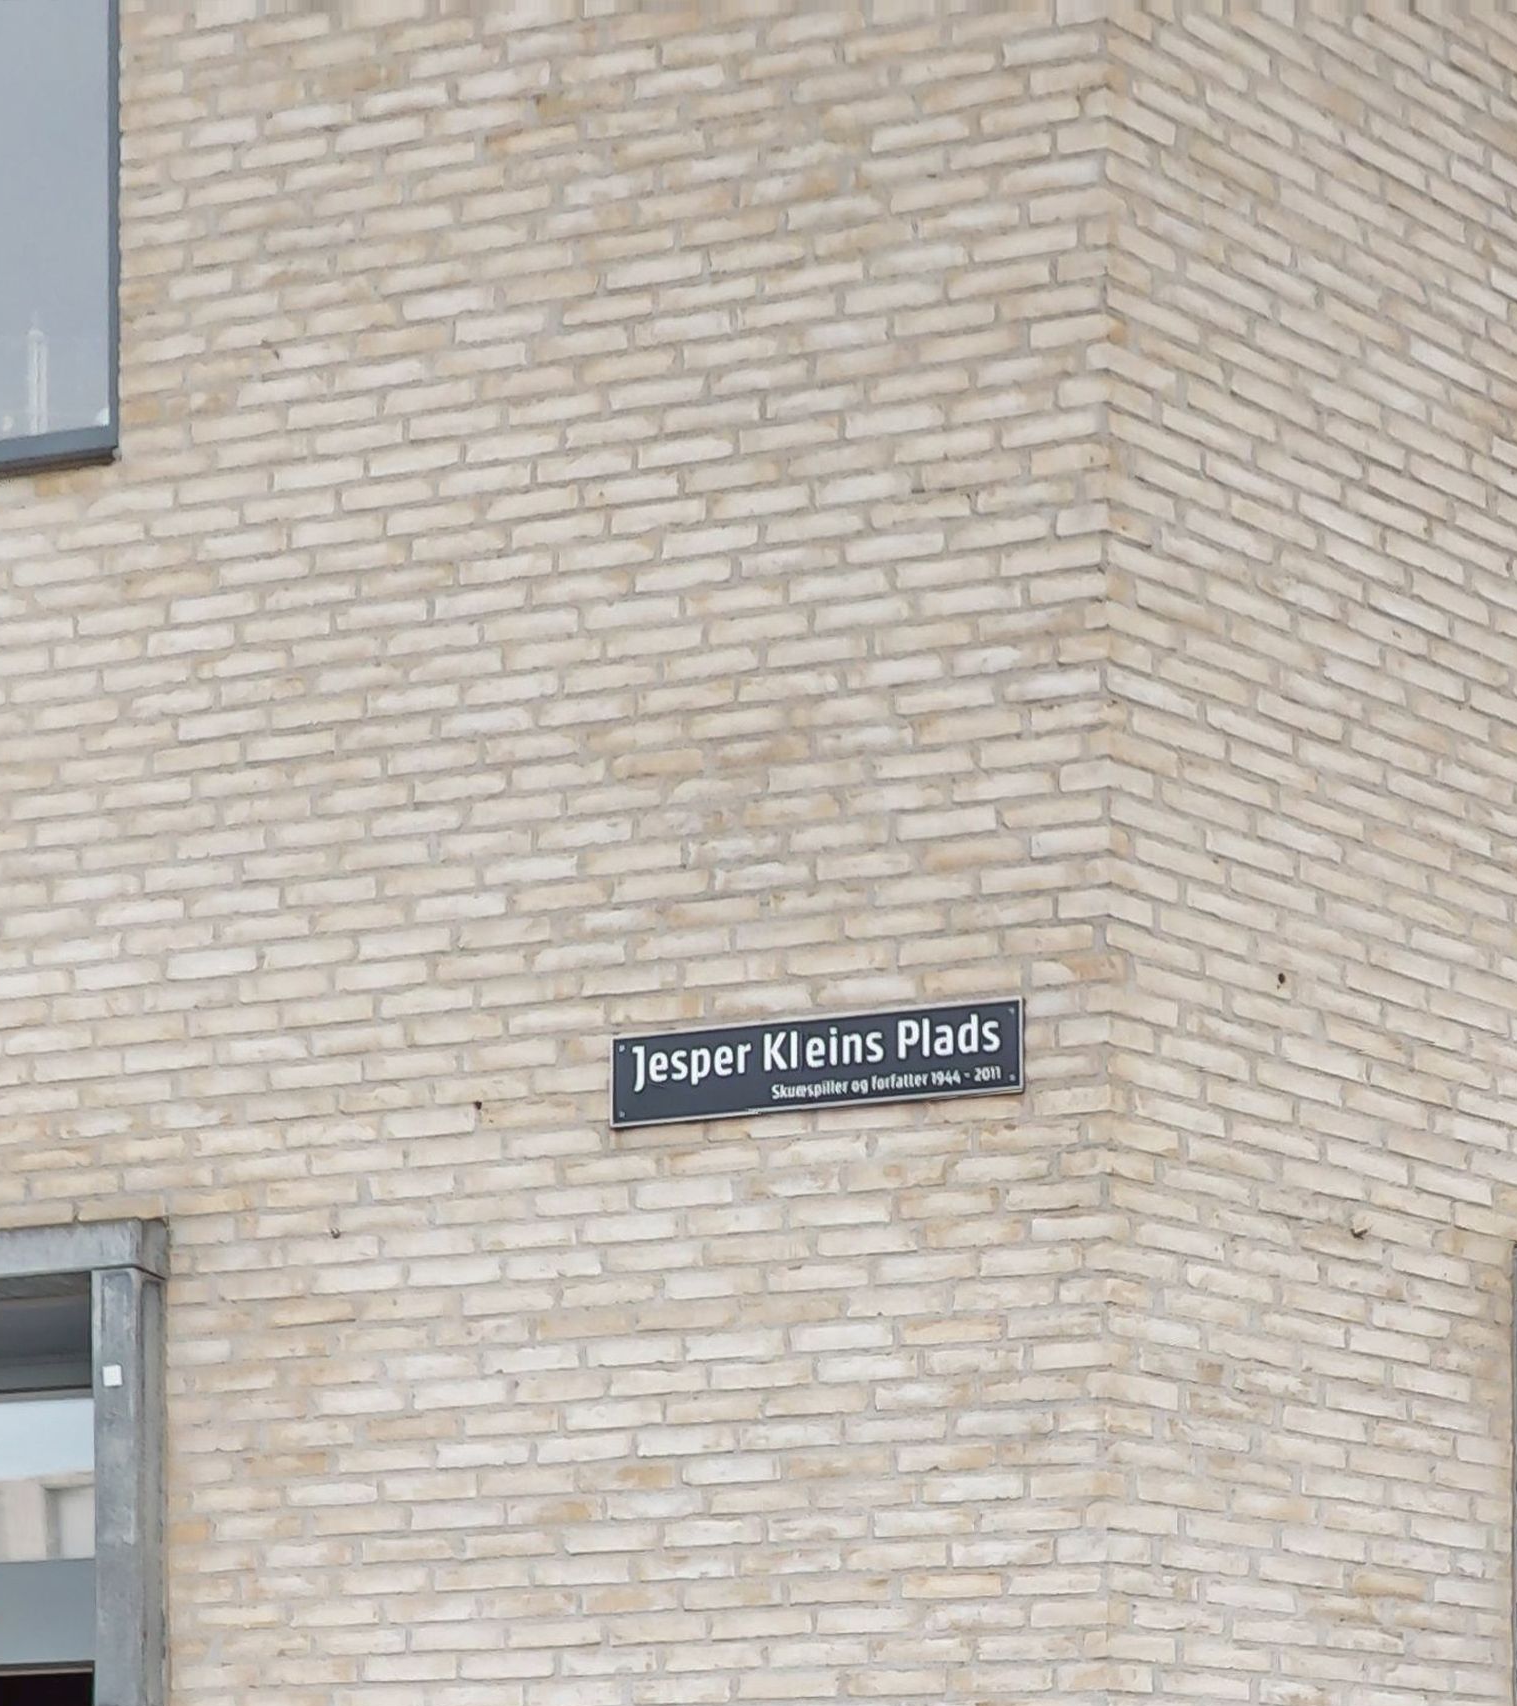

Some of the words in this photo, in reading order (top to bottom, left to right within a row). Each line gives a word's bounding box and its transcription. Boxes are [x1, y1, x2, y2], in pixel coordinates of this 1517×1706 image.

[632, 1042, 752, 1093] Jesper
[763, 1028, 884, 1073] Kleins
[897, 1013, 1001, 1060] Plads
[851, 1078, 869, 1095] og
[871, 1072, 929, 1091] forfatter
[930, 1069, 962, 1087] 1944
[974, 1065, 1002, 1083] 2011
